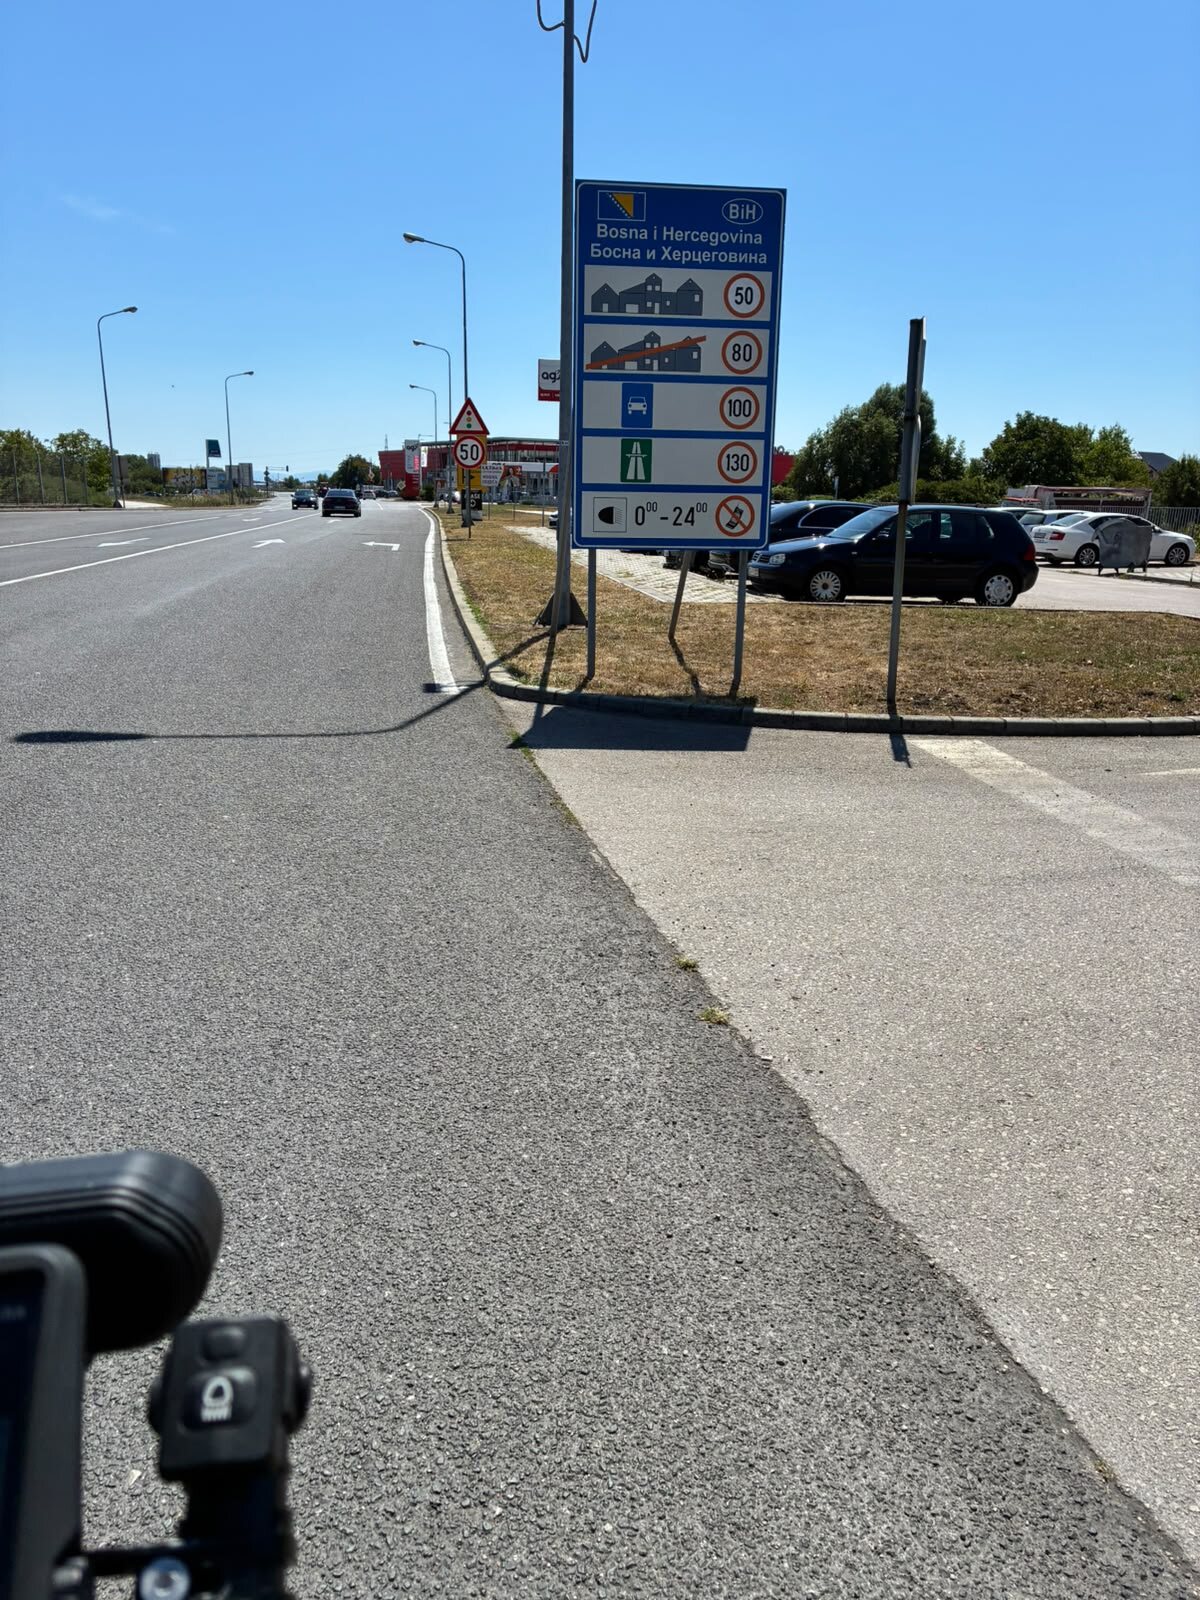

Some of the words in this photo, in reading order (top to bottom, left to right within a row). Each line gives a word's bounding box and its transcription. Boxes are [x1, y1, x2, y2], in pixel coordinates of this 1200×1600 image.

[729, 204, 756, 219] BiH
[597, 224, 648, 240] Bosna
[653, 226, 657, 240] i
[663, 226, 763, 246] Hercegovina
[591, 243, 641, 259] Босна
[646, 248, 656, 259] и
[661, 246, 767, 264] Херцеговина
[734, 286, 753, 305] 50
[731, 343, 752, 362] 80
[727, 399, 752, 418] 100
[459, 444, 480, 461] 50
[725, 454, 750, 472] 130
